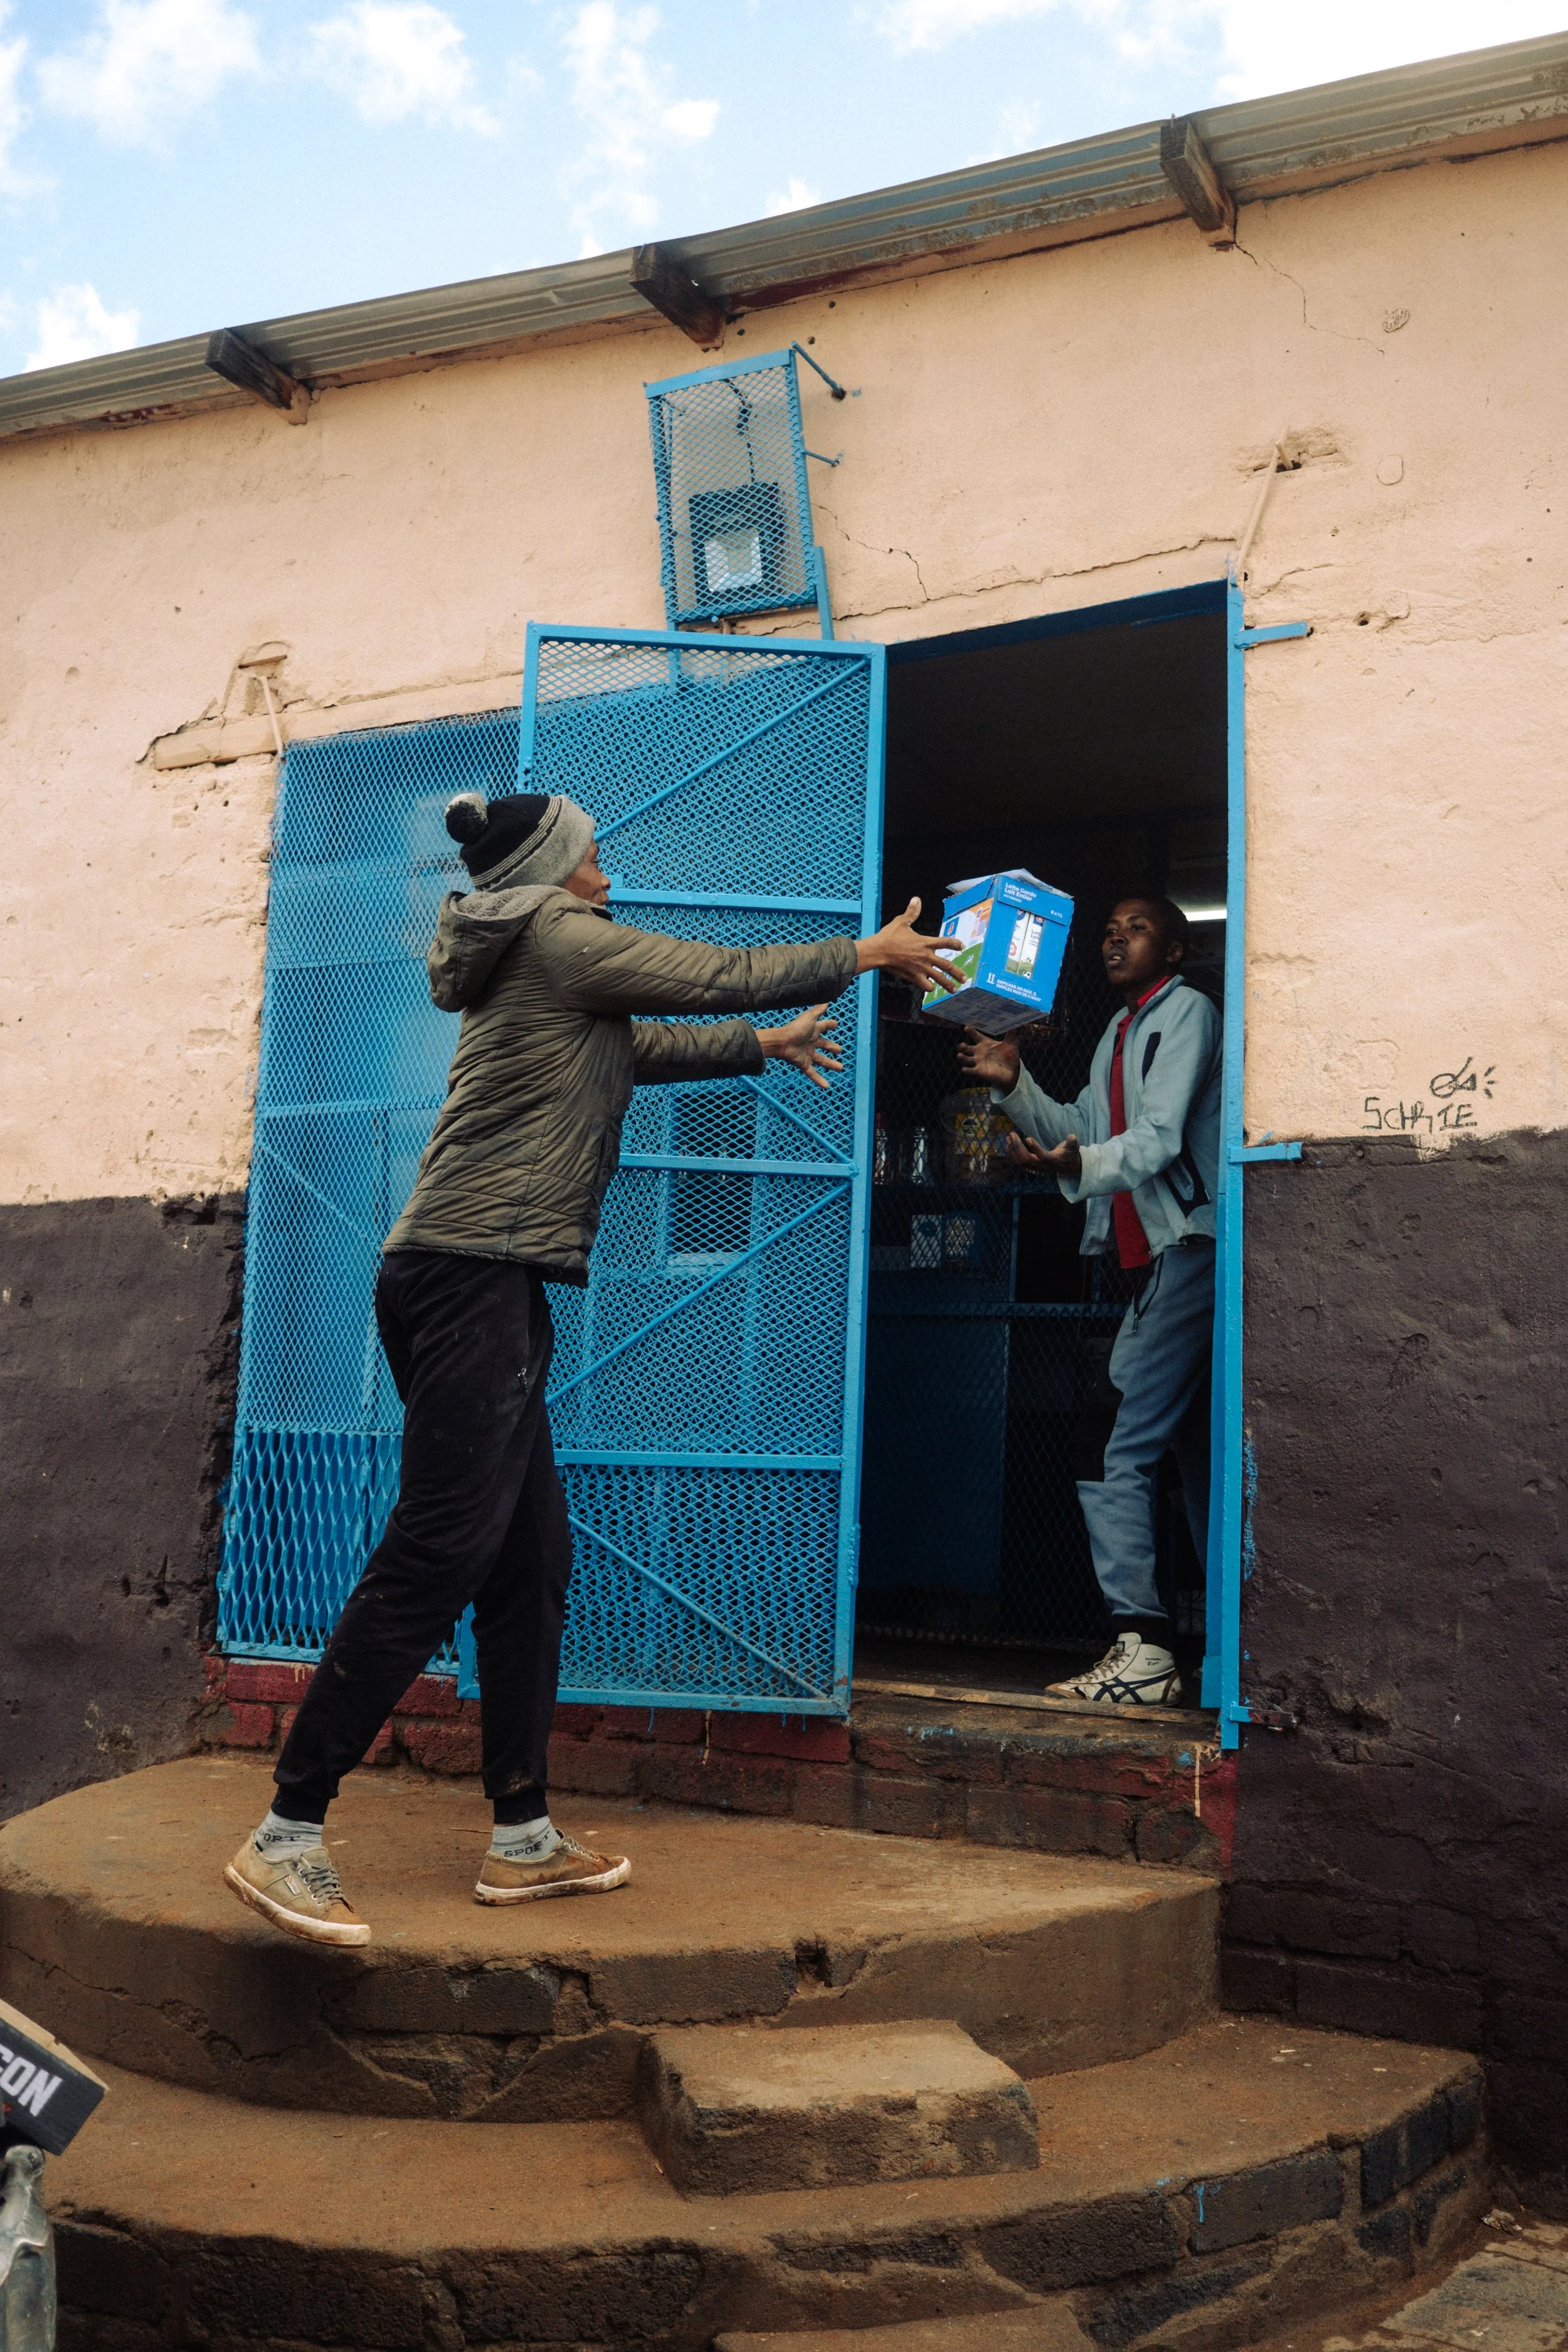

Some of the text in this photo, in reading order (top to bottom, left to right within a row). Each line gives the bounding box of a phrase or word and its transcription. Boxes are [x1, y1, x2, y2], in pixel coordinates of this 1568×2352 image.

[1004, 887, 1016, 896] Lait
[1016, 892, 1033, 902] Entier
[1005, 882, 1037, 898] Leite Gordo
[997, 980, 1016, 989] EMPILHAR
